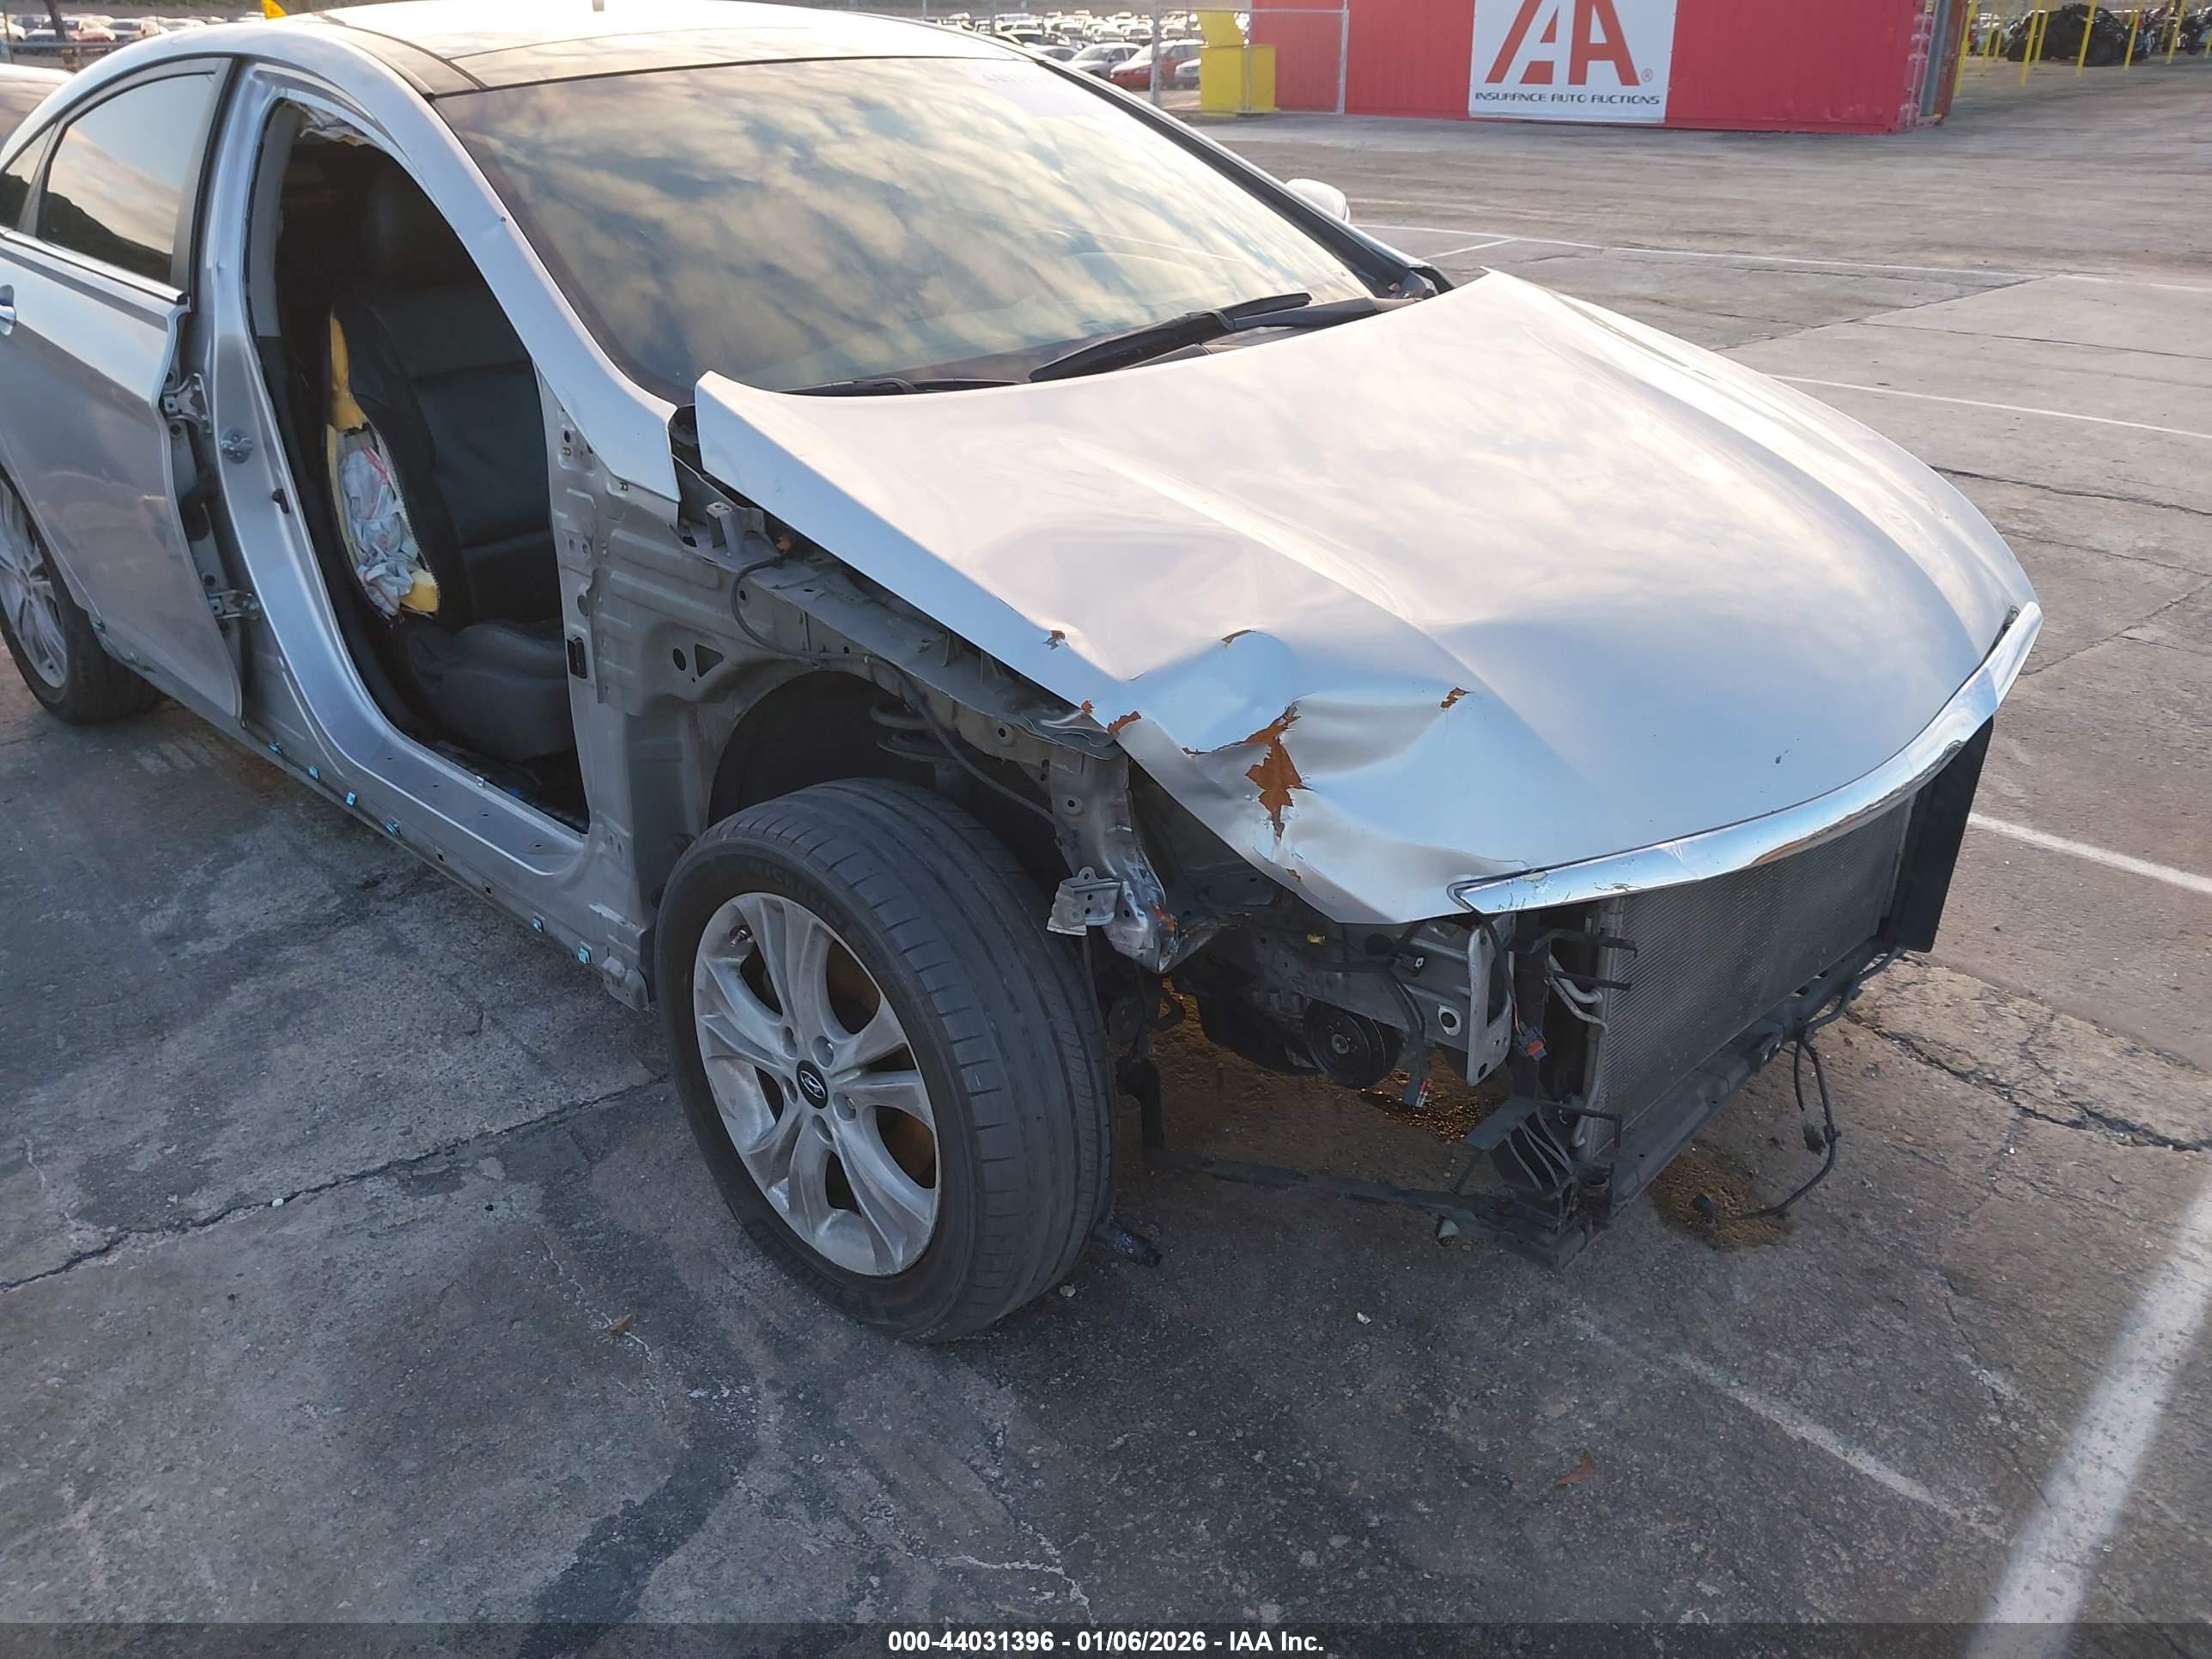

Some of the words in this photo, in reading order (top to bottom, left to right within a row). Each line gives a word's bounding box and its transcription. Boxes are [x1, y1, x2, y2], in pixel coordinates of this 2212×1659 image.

[1474, 91, 1546, 101] INSURANCE
[1551, 93, 1587, 103] AUTO
[1591, 94, 1660, 105] AUCTIONS
